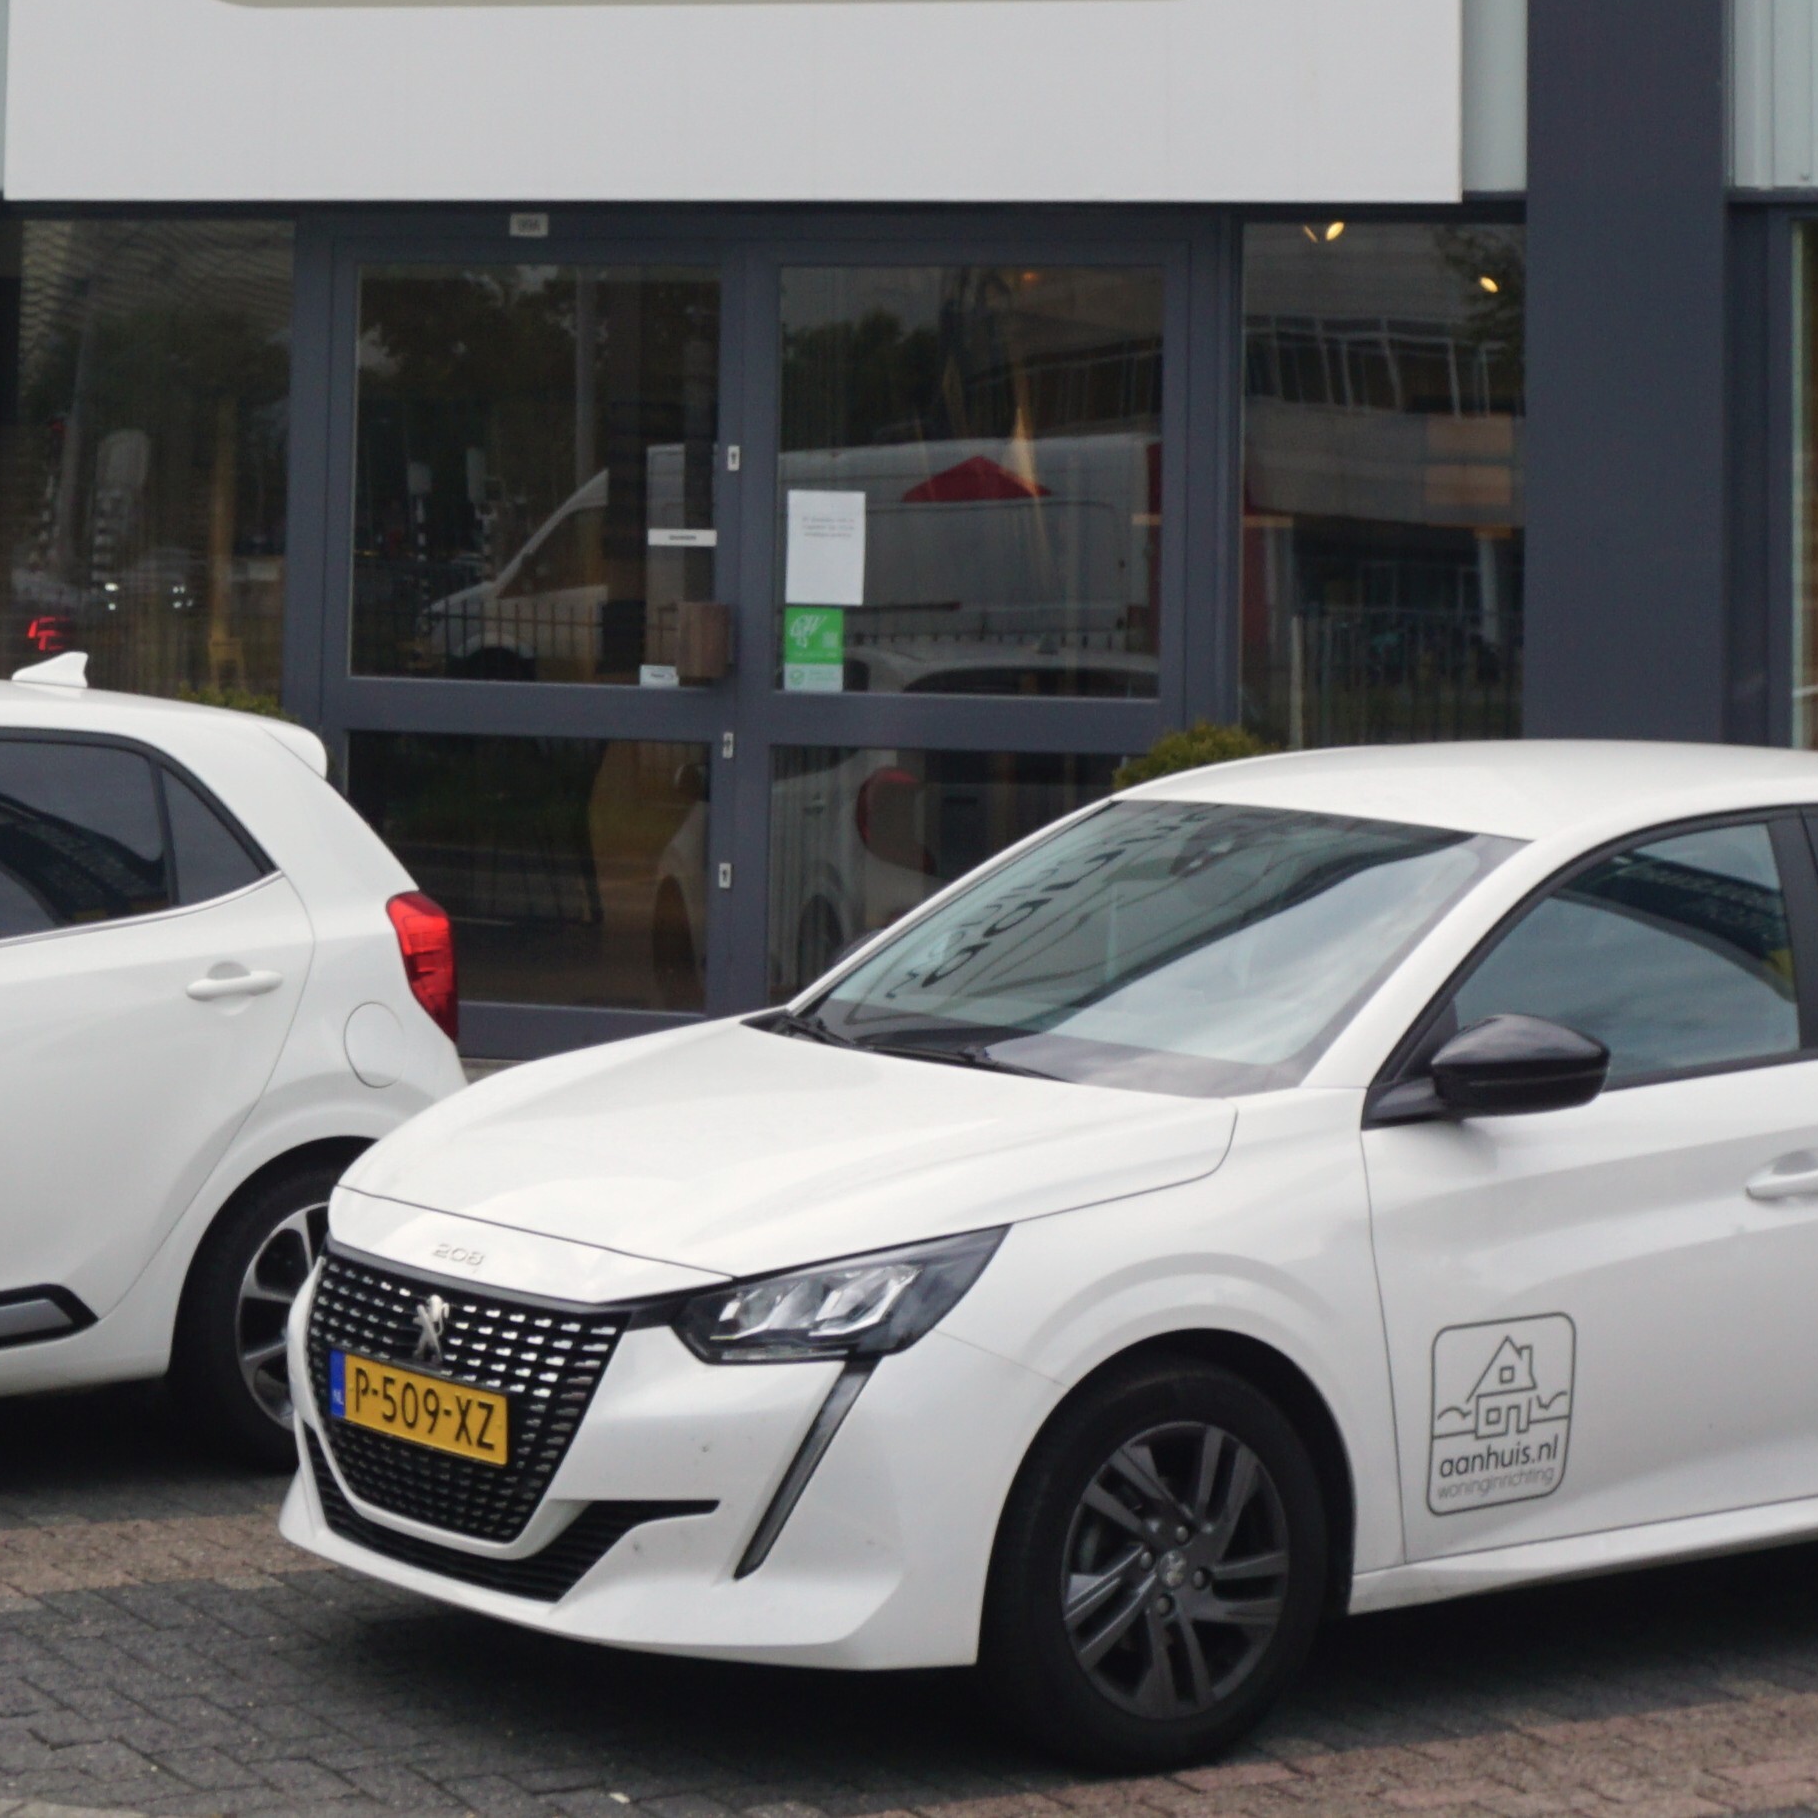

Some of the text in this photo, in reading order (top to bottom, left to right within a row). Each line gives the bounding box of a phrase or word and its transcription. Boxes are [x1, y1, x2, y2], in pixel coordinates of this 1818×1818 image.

[433, 1242, 486, 1268] 208
[354, 1367, 496, 1451] P-509-XZ
[1439, 1432, 1559, 1479] aanhuis.nl
[1437, 1466, 1555, 1500] woninginrichting
